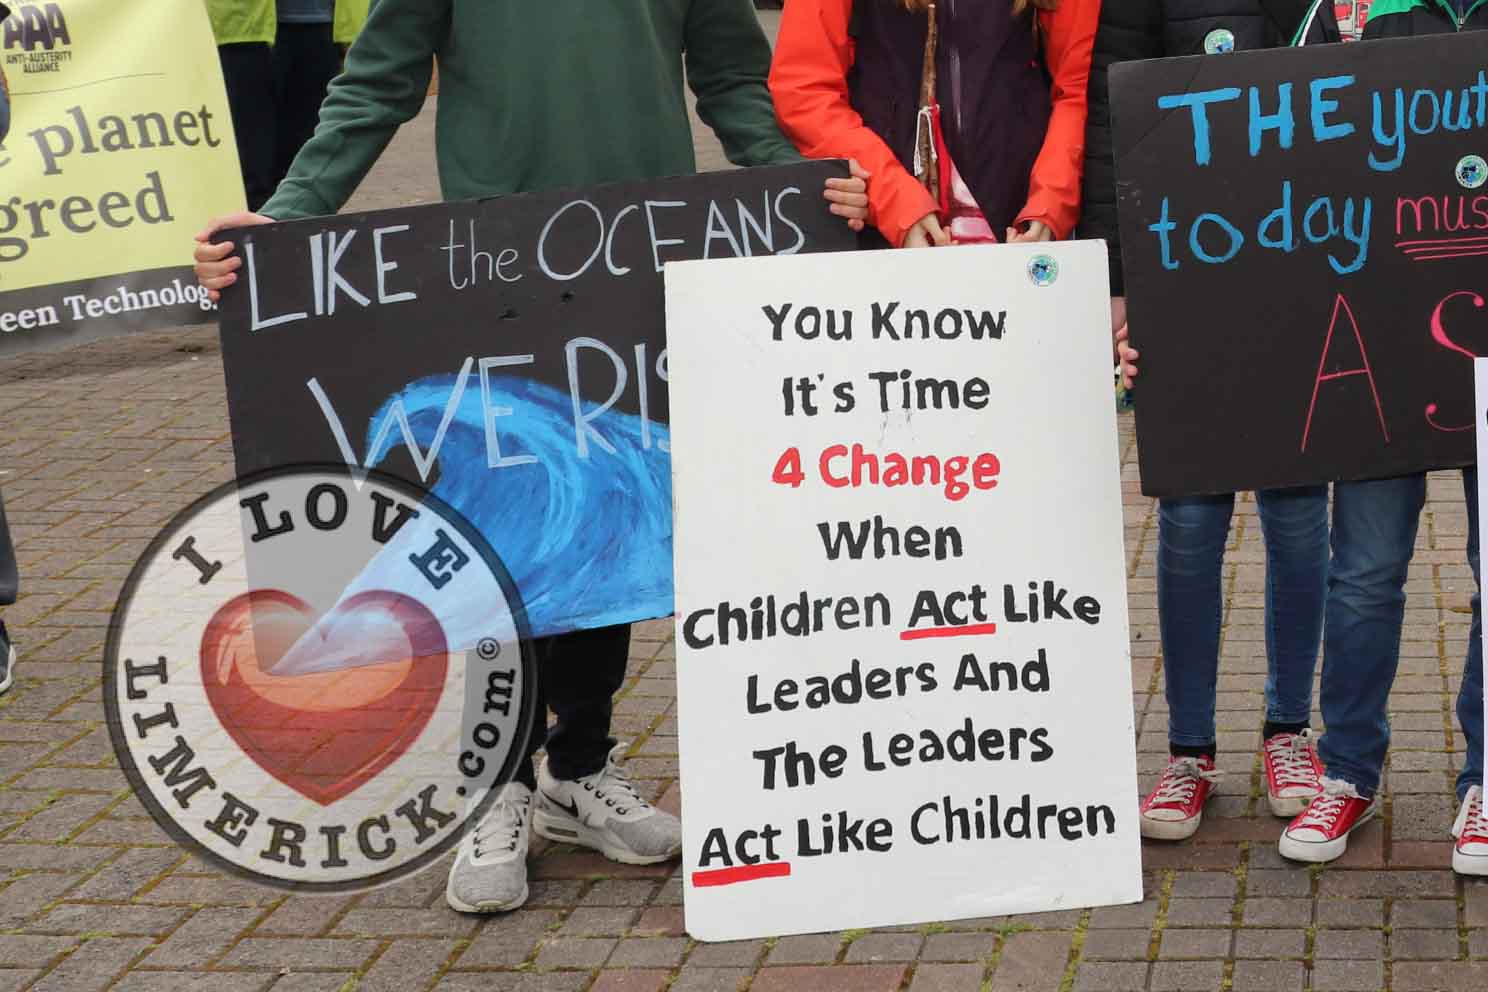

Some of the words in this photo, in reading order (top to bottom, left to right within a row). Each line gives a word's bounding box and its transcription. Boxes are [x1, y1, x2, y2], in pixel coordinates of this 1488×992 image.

[24, 62, 60, 73] ALLIANCE
[27, 104, 221, 176] planet
[1157, 73, 1356, 168] THE
[245, 224, 417, 331] LIKE
[440, 218, 522, 289] the
[537, 186, 805, 281] OCEANS
[1148, 180, 1372, 275] today
[64, 278, 219, 321] Technolog
[761, 302, 853, 341] You
[871, 301, 1007, 341] Know
[782, 373, 855, 416] It's
[869, 369, 991, 413] Time
[1301, 292, 1391, 452] A
[308, 353, 538, 492] WE
[771, 447, 805, 489] 4
[818, 443, 1001, 502] Change
[817, 515, 963, 561] When
[682, 591, 891, 650] Children
[908, 584, 988, 628] Act
[1004, 580, 1101, 624] Like
[747, 659, 938, 714] Leaders
[953, 648, 1050, 692] And
[753, 741, 848, 790] The
[862, 717, 1054, 771] Leaders
[698, 824, 782, 868] Act
[797, 811, 893, 857] Like
[910, 794, 1116, 845] Children
